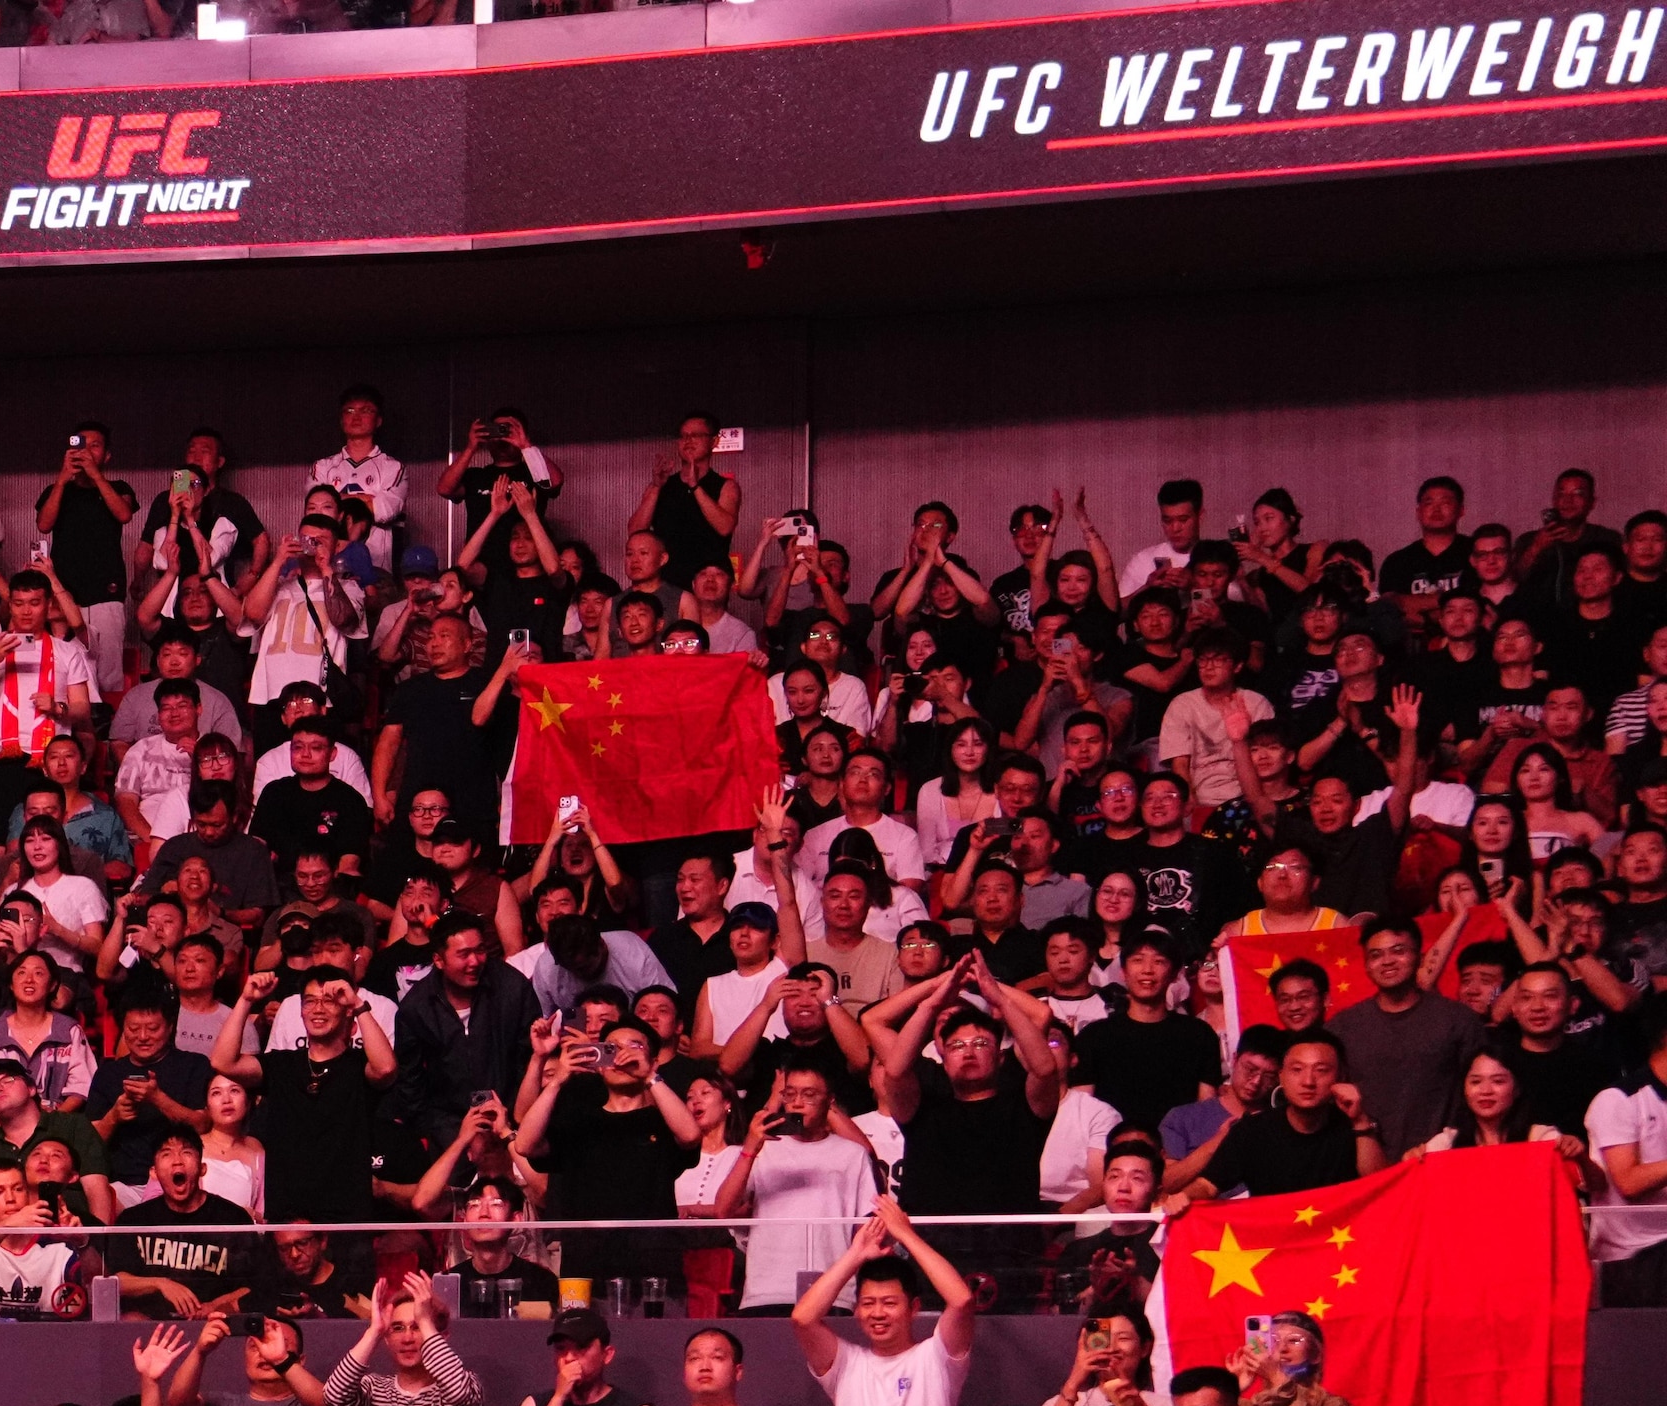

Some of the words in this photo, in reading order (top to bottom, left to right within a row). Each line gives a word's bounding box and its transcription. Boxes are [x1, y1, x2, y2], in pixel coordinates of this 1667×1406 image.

[920, 62, 1061, 142] UFC
[46, 110, 221, 178] UFC
[0, 183, 146, 231] FIGHT
[145, 179, 251, 213] NIGHT
[136, 1235, 229, 1276] ALENCIAGA
